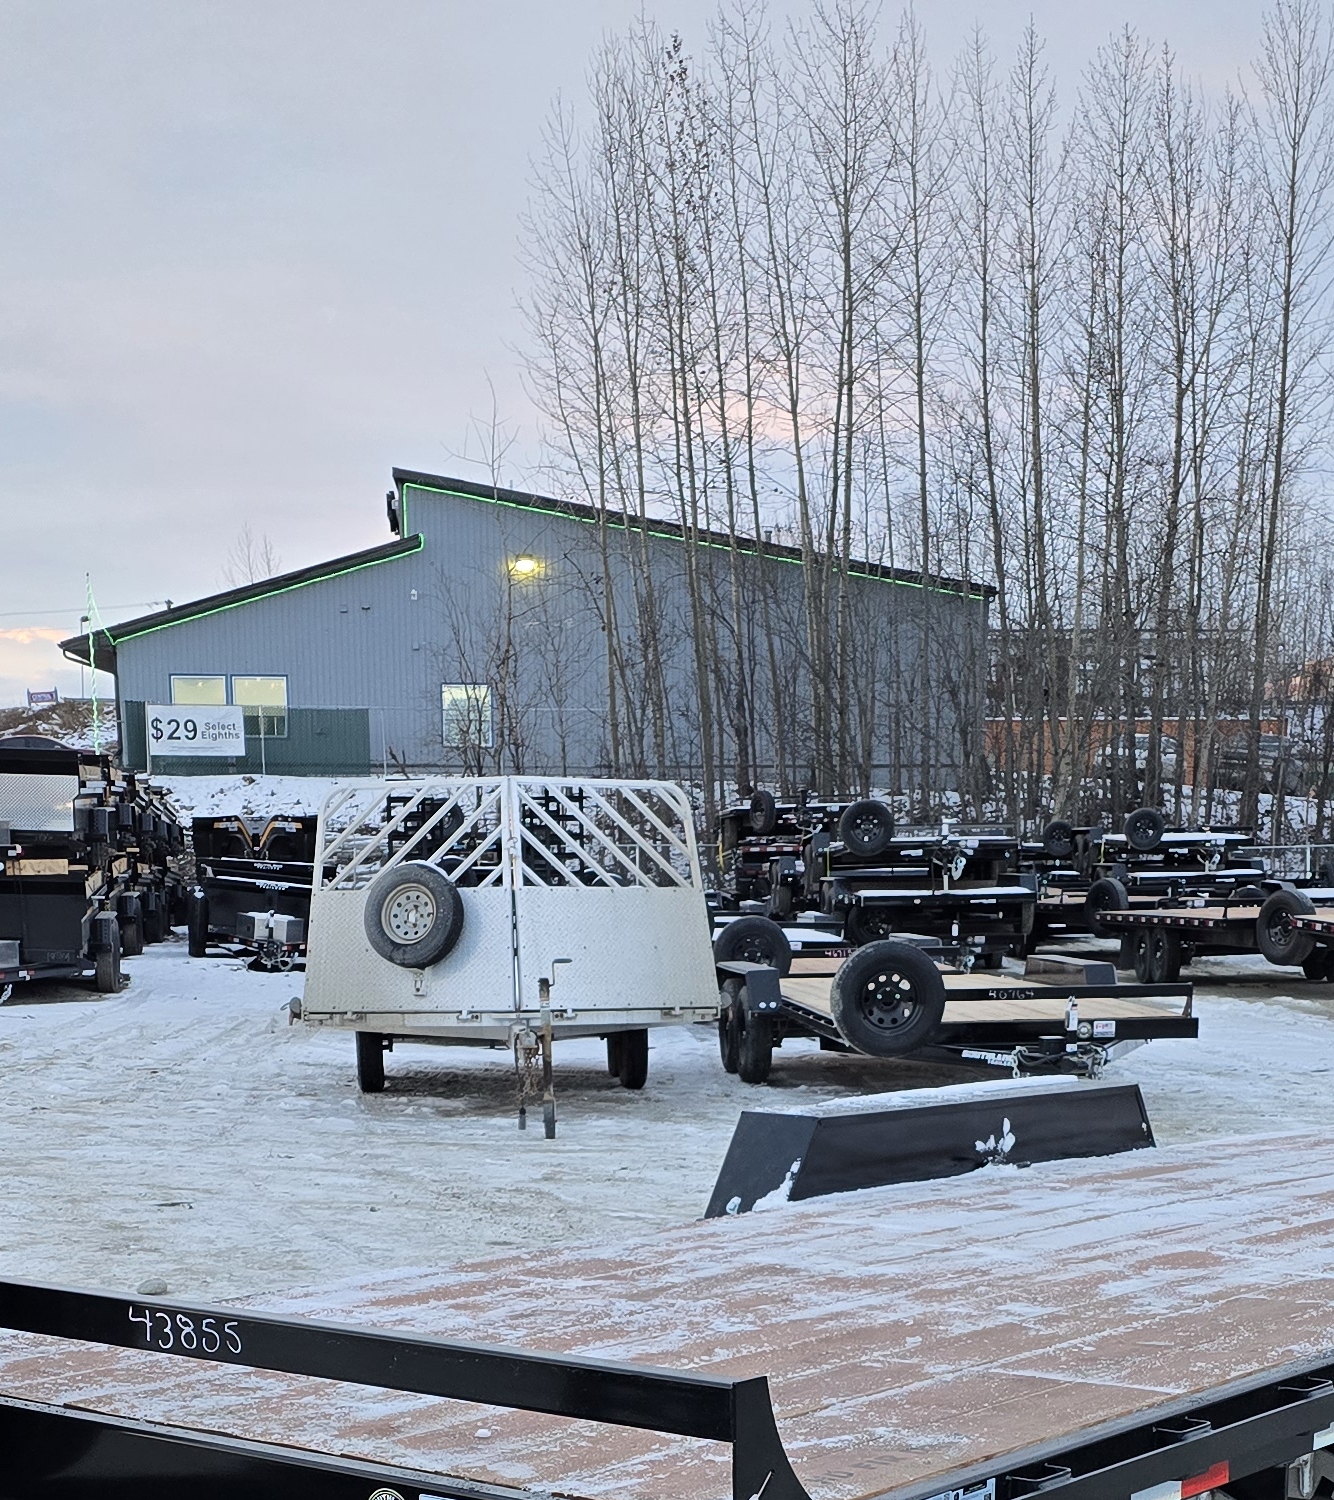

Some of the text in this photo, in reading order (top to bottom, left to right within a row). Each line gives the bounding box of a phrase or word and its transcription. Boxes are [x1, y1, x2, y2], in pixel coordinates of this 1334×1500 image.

[151, 717, 198, 743] $29
[204, 722, 236, 731] Select
[201, 731, 240, 741] Eighths
[989, 989, 1034, 999] 40764
[128, 1306, 242, 1354] 43855
